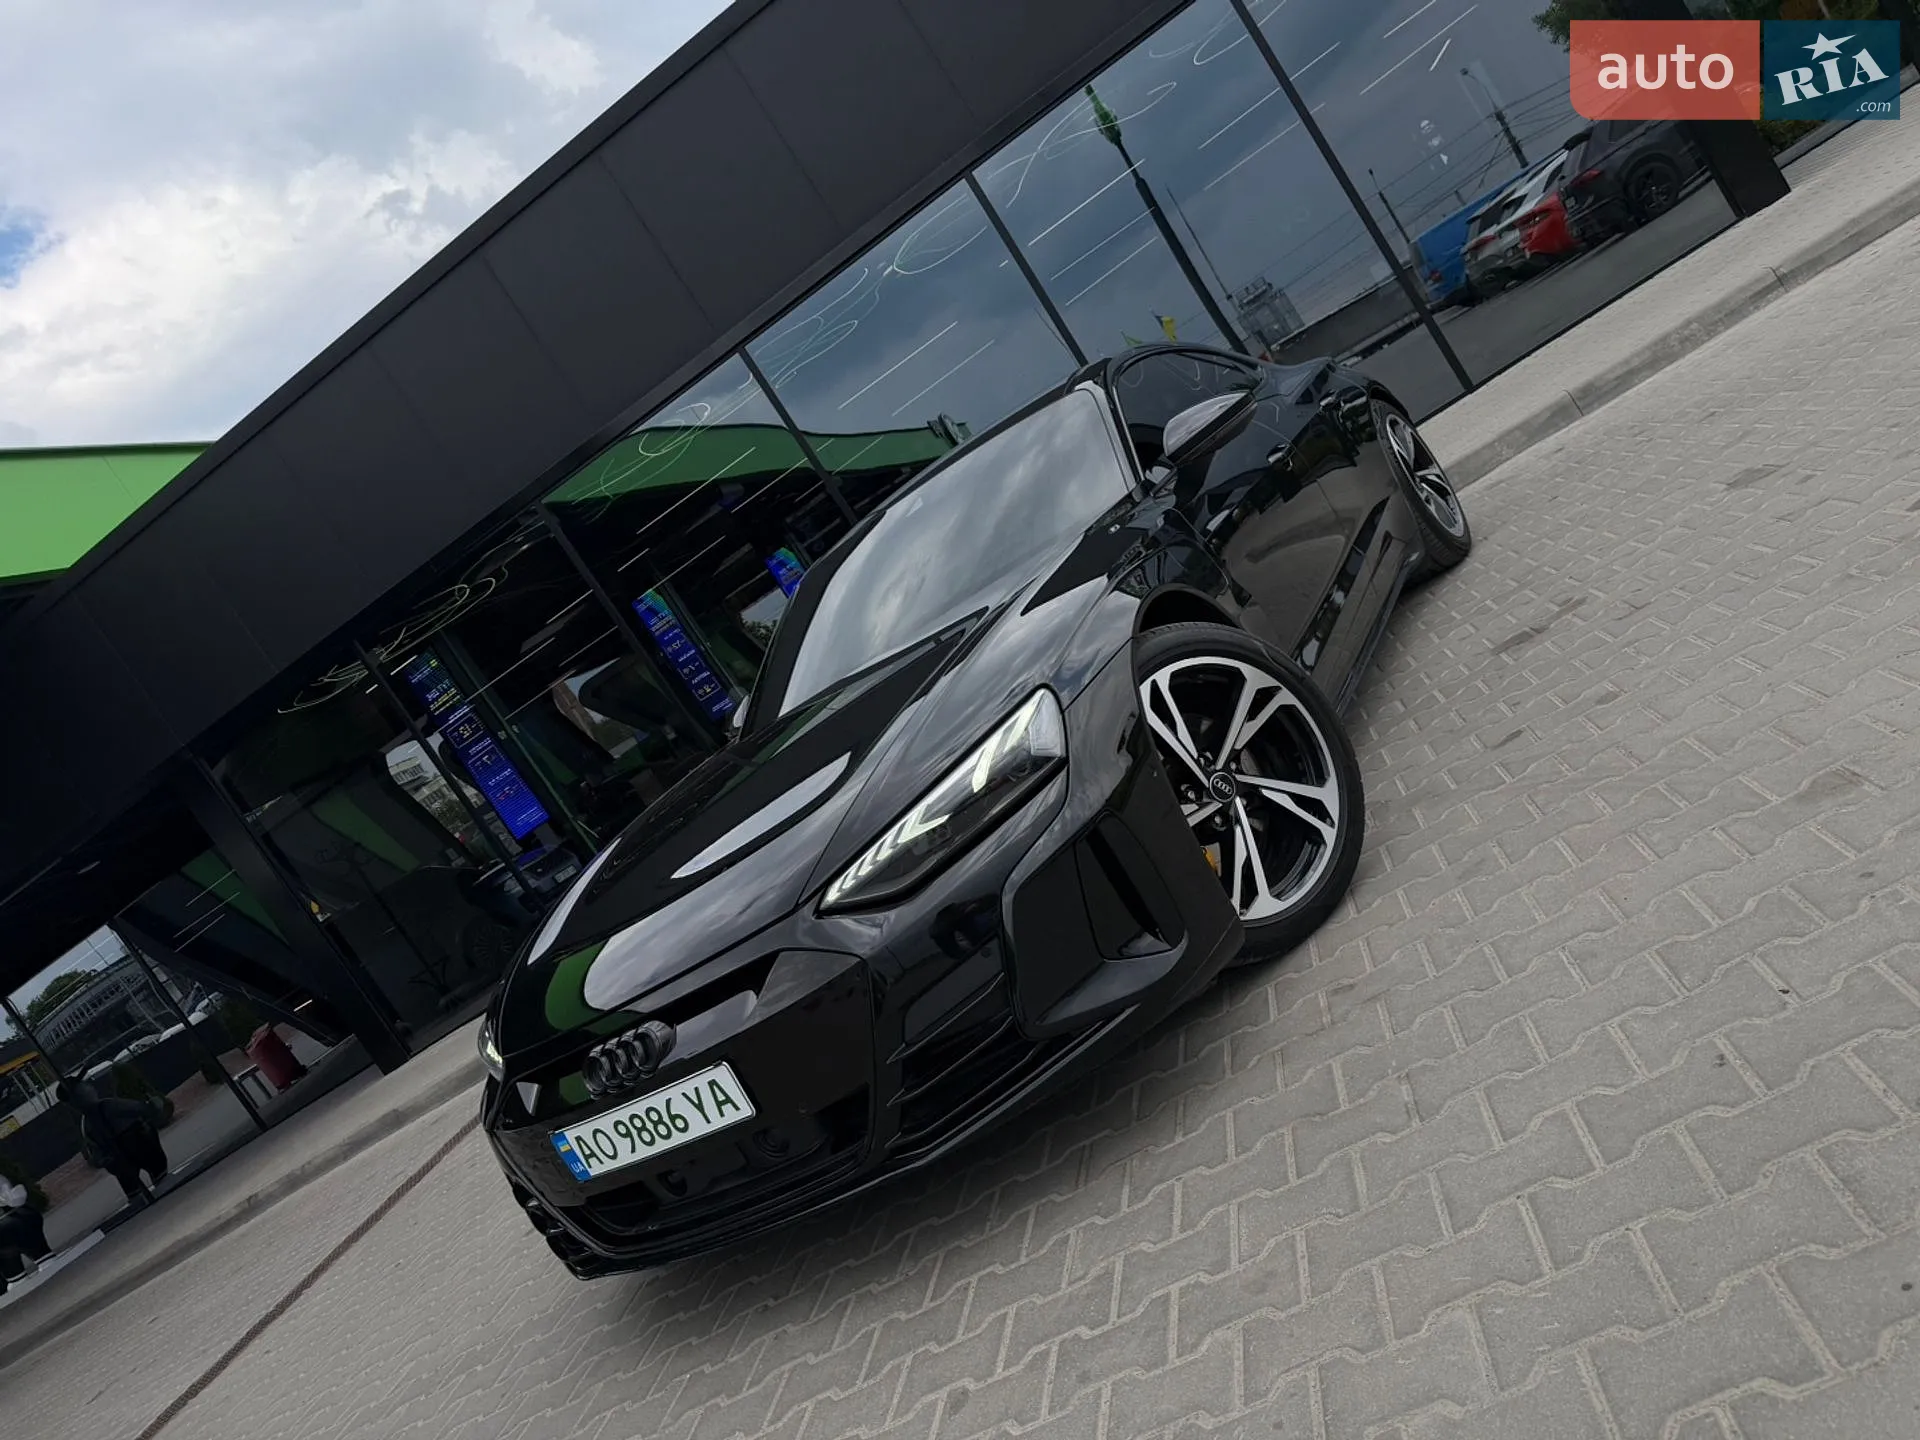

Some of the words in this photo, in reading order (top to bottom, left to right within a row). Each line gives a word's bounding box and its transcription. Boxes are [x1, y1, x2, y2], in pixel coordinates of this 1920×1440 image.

[574, 1127, 619, 1169] AO
[613, 1097, 690, 1155] 9886
[681, 1078, 741, 1125] YA
[571, 1161, 585, 1174] UA
